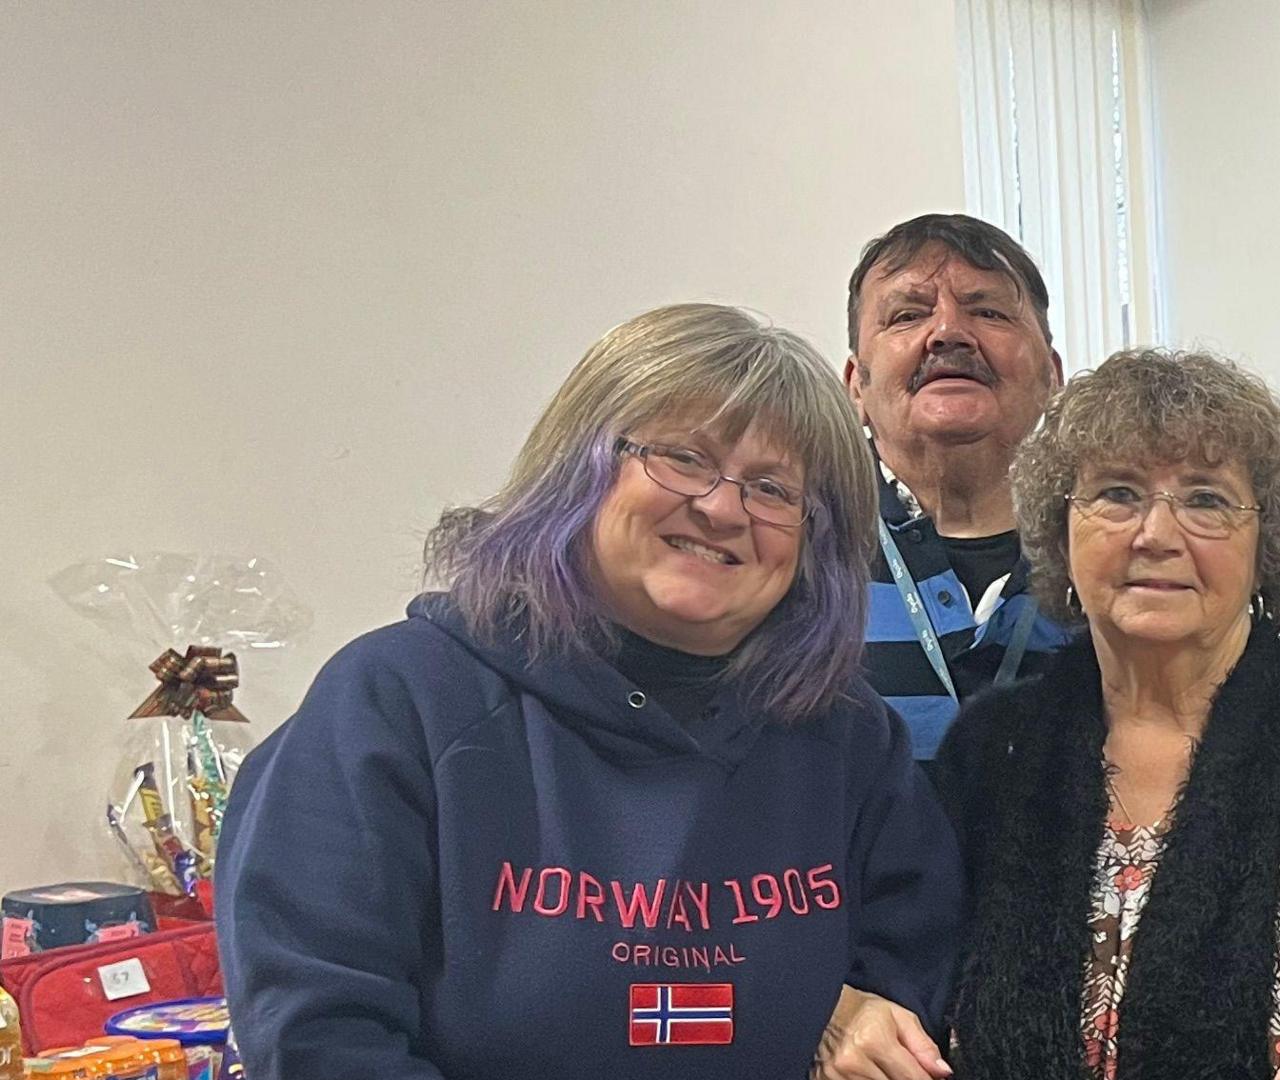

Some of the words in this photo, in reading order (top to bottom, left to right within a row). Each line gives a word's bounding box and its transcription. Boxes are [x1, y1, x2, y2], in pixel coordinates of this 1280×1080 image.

[492, 861, 711, 932] NORWAY
[723, 863, 842, 925] 1905
[611, 942, 746, 973] ORIGINAL
